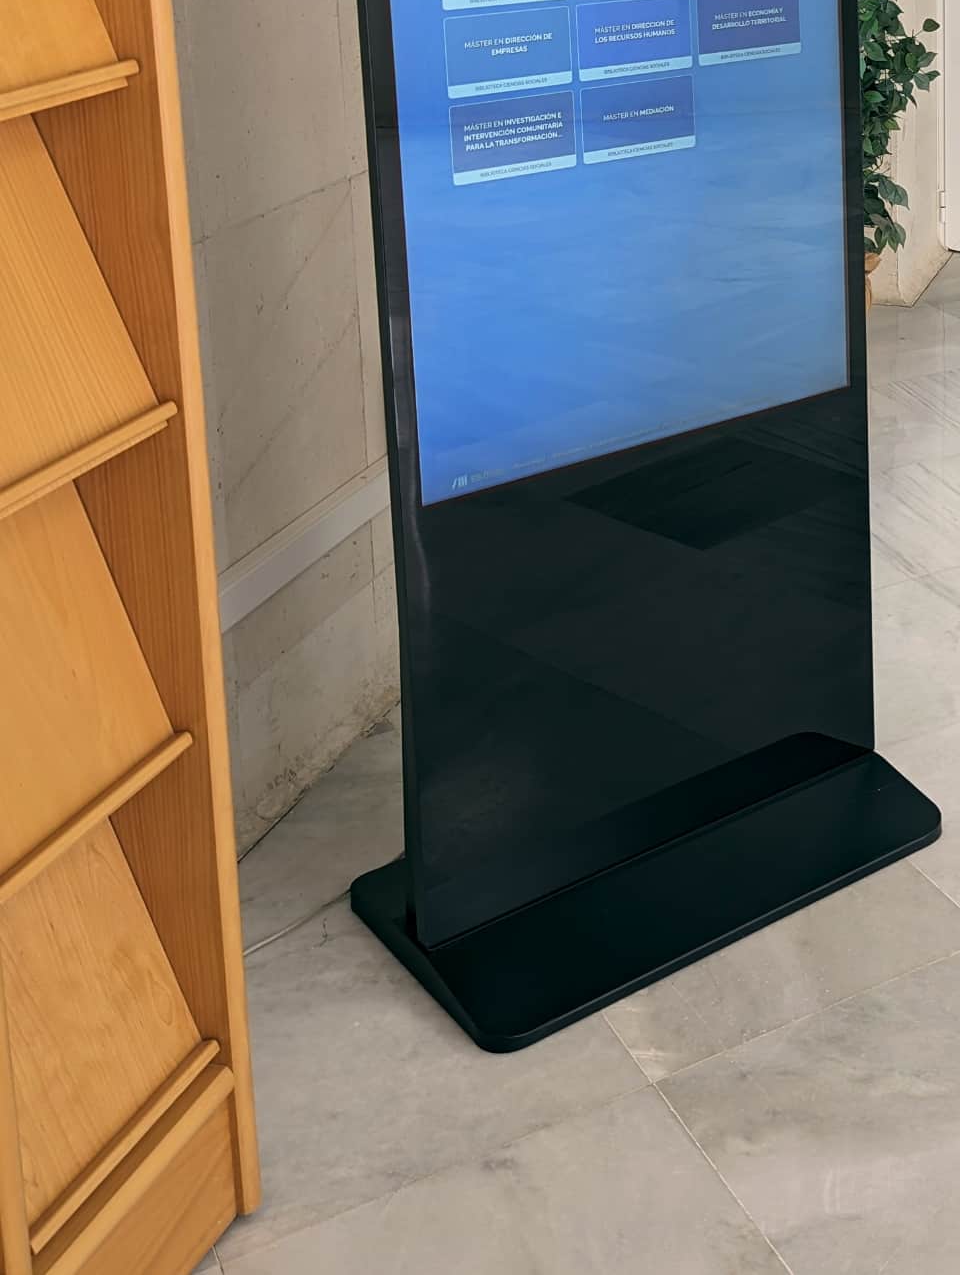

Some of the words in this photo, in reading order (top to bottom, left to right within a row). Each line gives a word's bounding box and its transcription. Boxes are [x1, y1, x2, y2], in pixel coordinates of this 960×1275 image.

[505, 34, 542, 44] DIRECCIÓN
[609, 32, 642, 41] RECURSOS
[644, 29, 675, 38] HUMANOS
[491, 46, 527, 56] EMPRESAS
[466, 143, 484, 151] PARA
